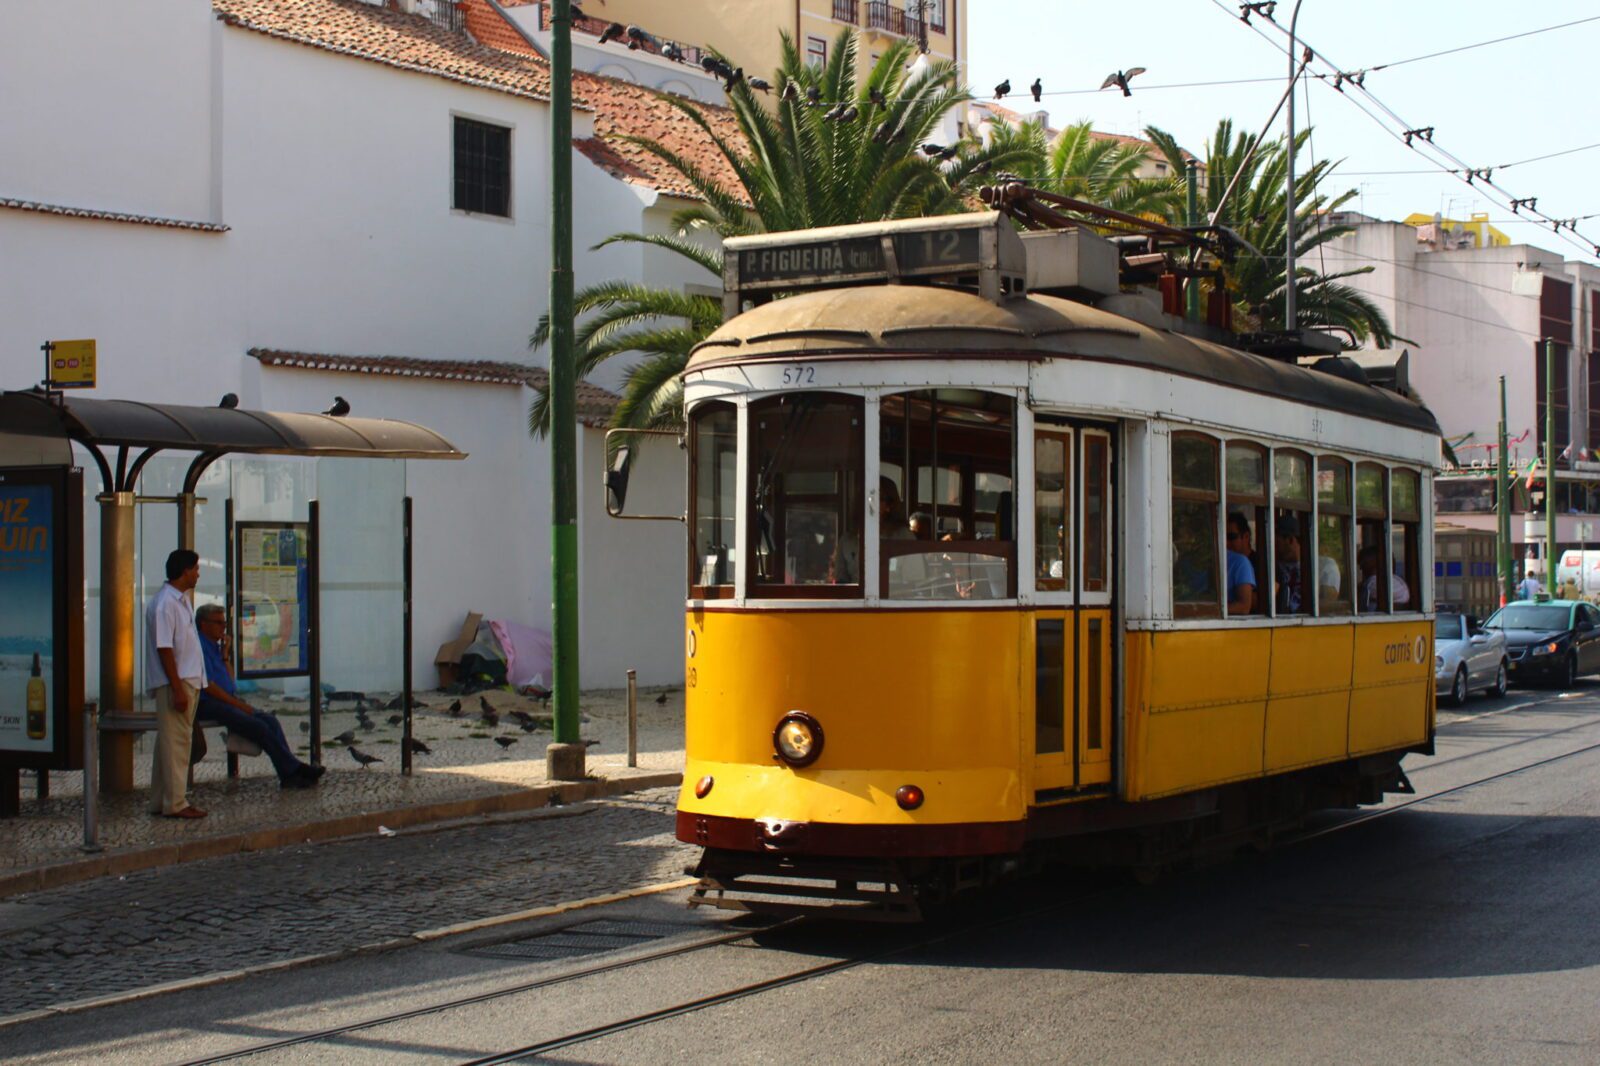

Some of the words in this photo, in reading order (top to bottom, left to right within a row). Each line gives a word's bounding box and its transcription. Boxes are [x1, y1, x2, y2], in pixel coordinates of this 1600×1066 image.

[922, 230, 961, 261] 12
[761, 247, 844, 272] FIGUEIRA
[783, 366, 815, 384] 572
[1384, 634, 1411, 664] carris
